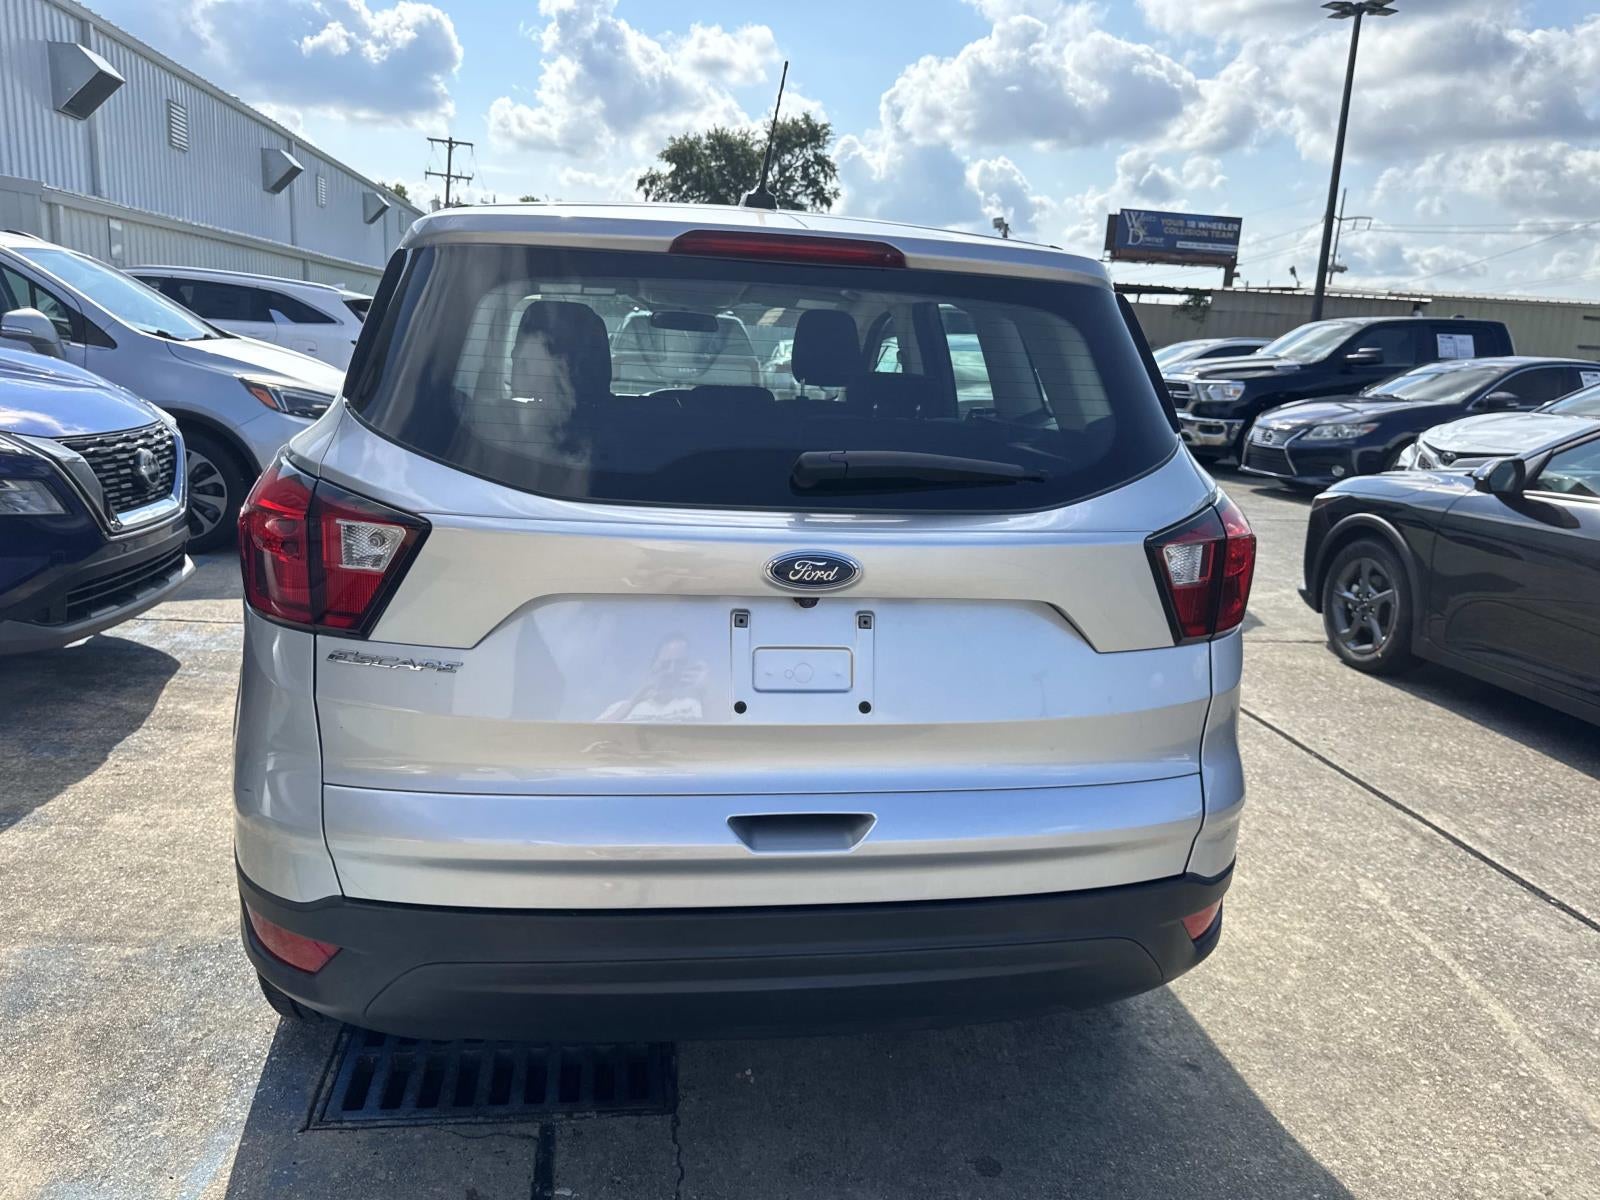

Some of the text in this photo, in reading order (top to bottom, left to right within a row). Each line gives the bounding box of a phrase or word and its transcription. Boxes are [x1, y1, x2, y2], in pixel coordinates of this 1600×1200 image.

[1163, 226, 1235, 239] COLLISION TEAM
[1198, 221, 1239, 231] WHEELER
[788, 560, 840, 581] Ford
[326, 649, 464, 674] ESCAPE
